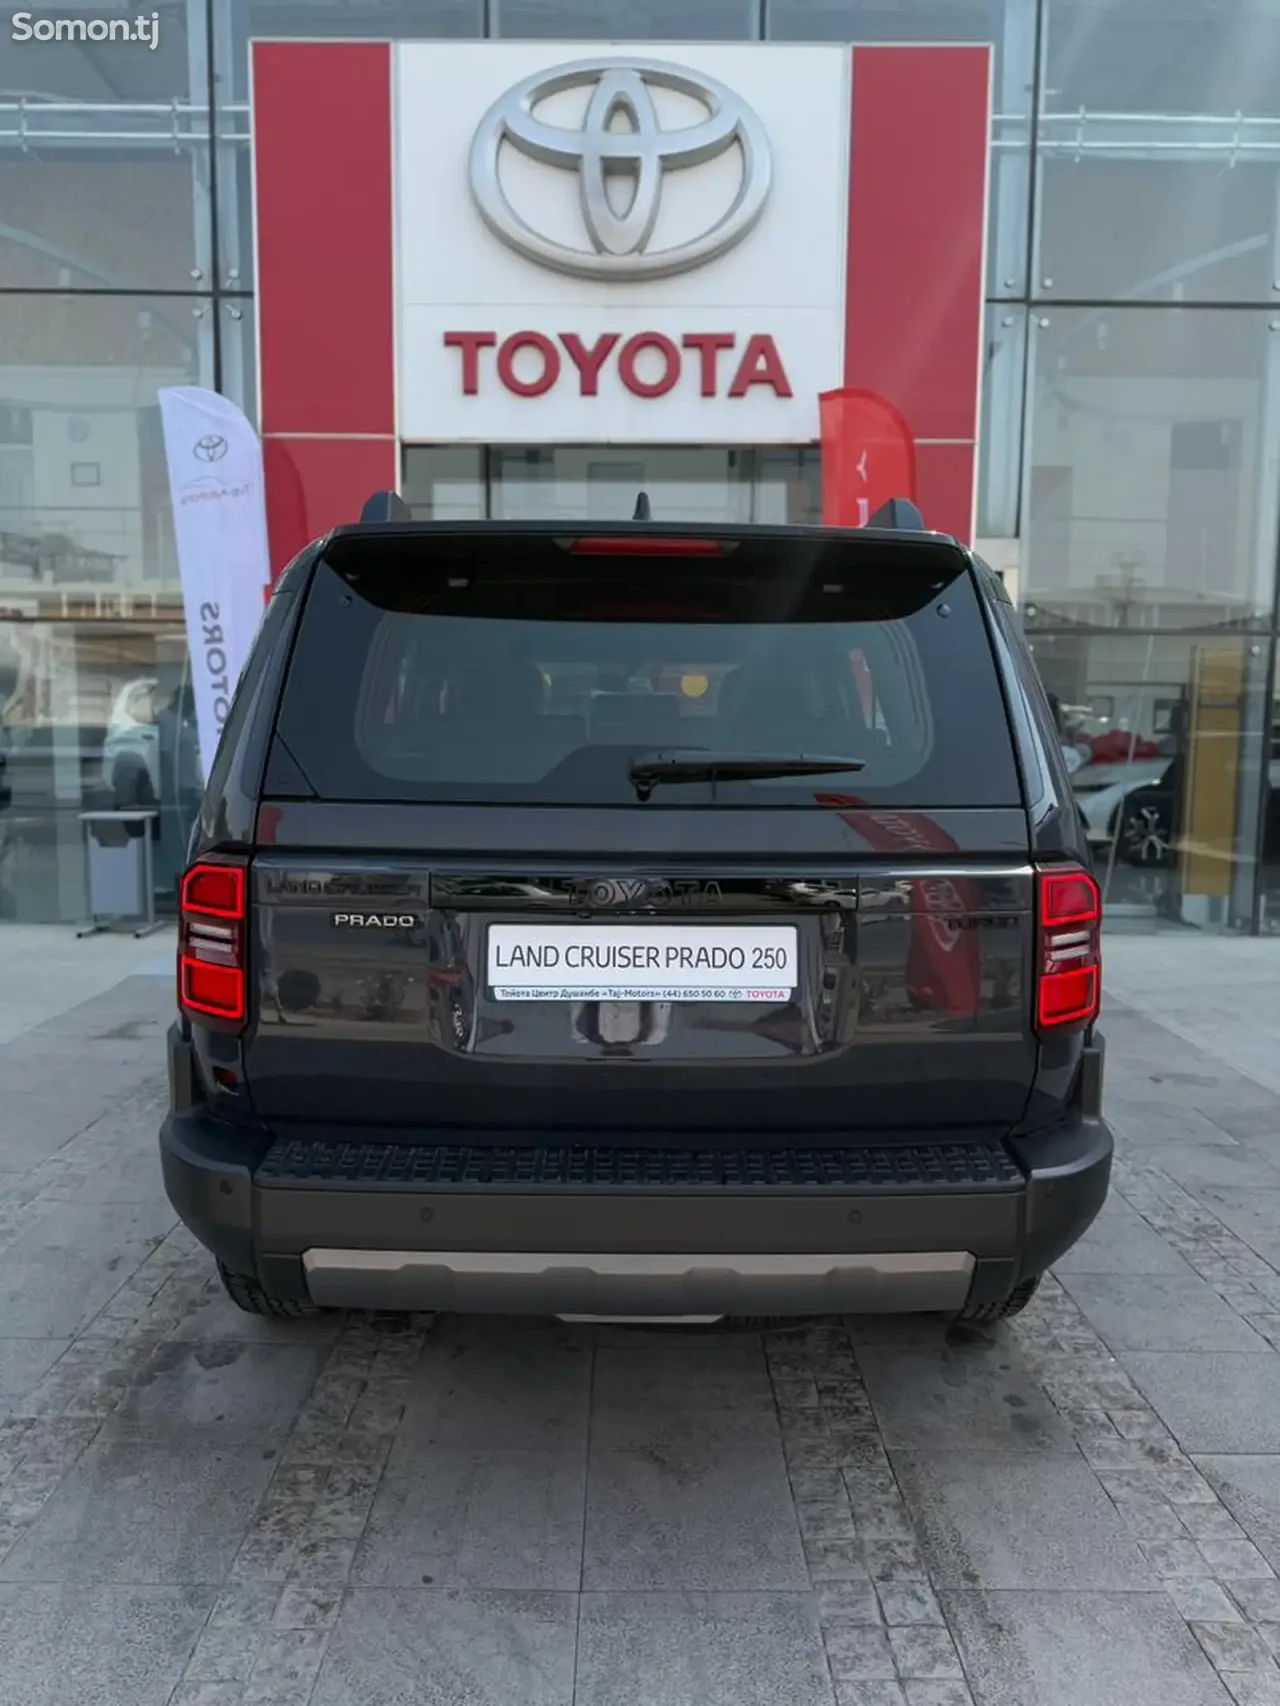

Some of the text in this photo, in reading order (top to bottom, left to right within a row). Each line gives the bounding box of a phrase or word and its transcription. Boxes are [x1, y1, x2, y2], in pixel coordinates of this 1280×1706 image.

[444, 330, 794, 399] TOYOTA
[564, 877, 725, 906] TOYOTA
[334, 914, 415, 927] PRADO
[495, 944, 787, 969] LAND CRUISER PRADO 250
[662, 989, 681, 999] (44)
[683, 990, 699, 998] 650
[701, 990, 713, 998] 50
[714, 990, 726, 998] 60
[746, 990, 785, 999] TOYOTA
